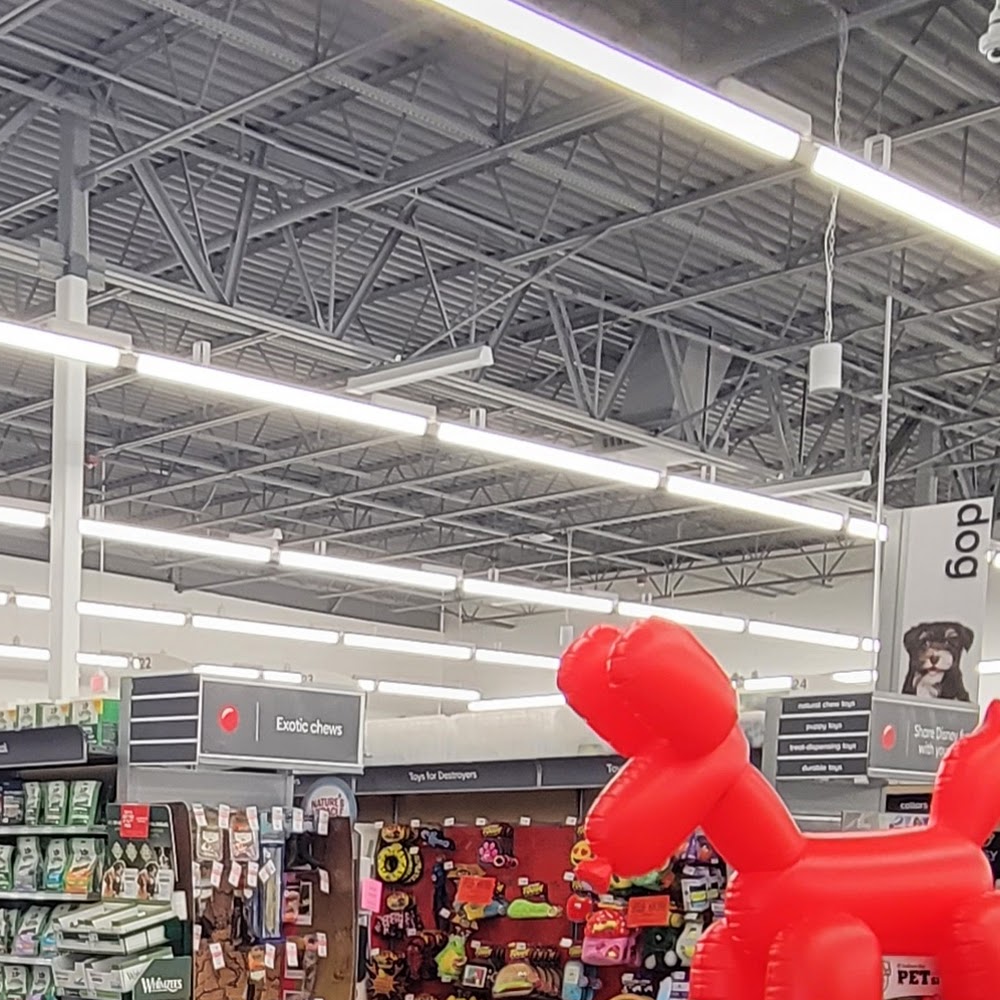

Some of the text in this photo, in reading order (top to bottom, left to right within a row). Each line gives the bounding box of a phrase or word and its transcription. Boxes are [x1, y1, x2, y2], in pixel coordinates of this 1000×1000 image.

[945, 503, 990, 579] dog
[792, 679, 807, 690] 24
[841, 700, 856, 709] toys
[276, 716, 343, 737] Exotic chews
[805, 722, 843, 732] puppy toys
[914, 724, 935, 739] Share
[789, 742, 857, 753] treat-dispensing toys
[918, 743, 934, 756] with
[801, 763, 843, 773] durable toys
[408, 769, 478, 783] Toys for Destroyers
[900, 802, 928, 811] collars
[897, 970, 931, 985] PET
[141, 977, 183, 994] WHIMZEES
